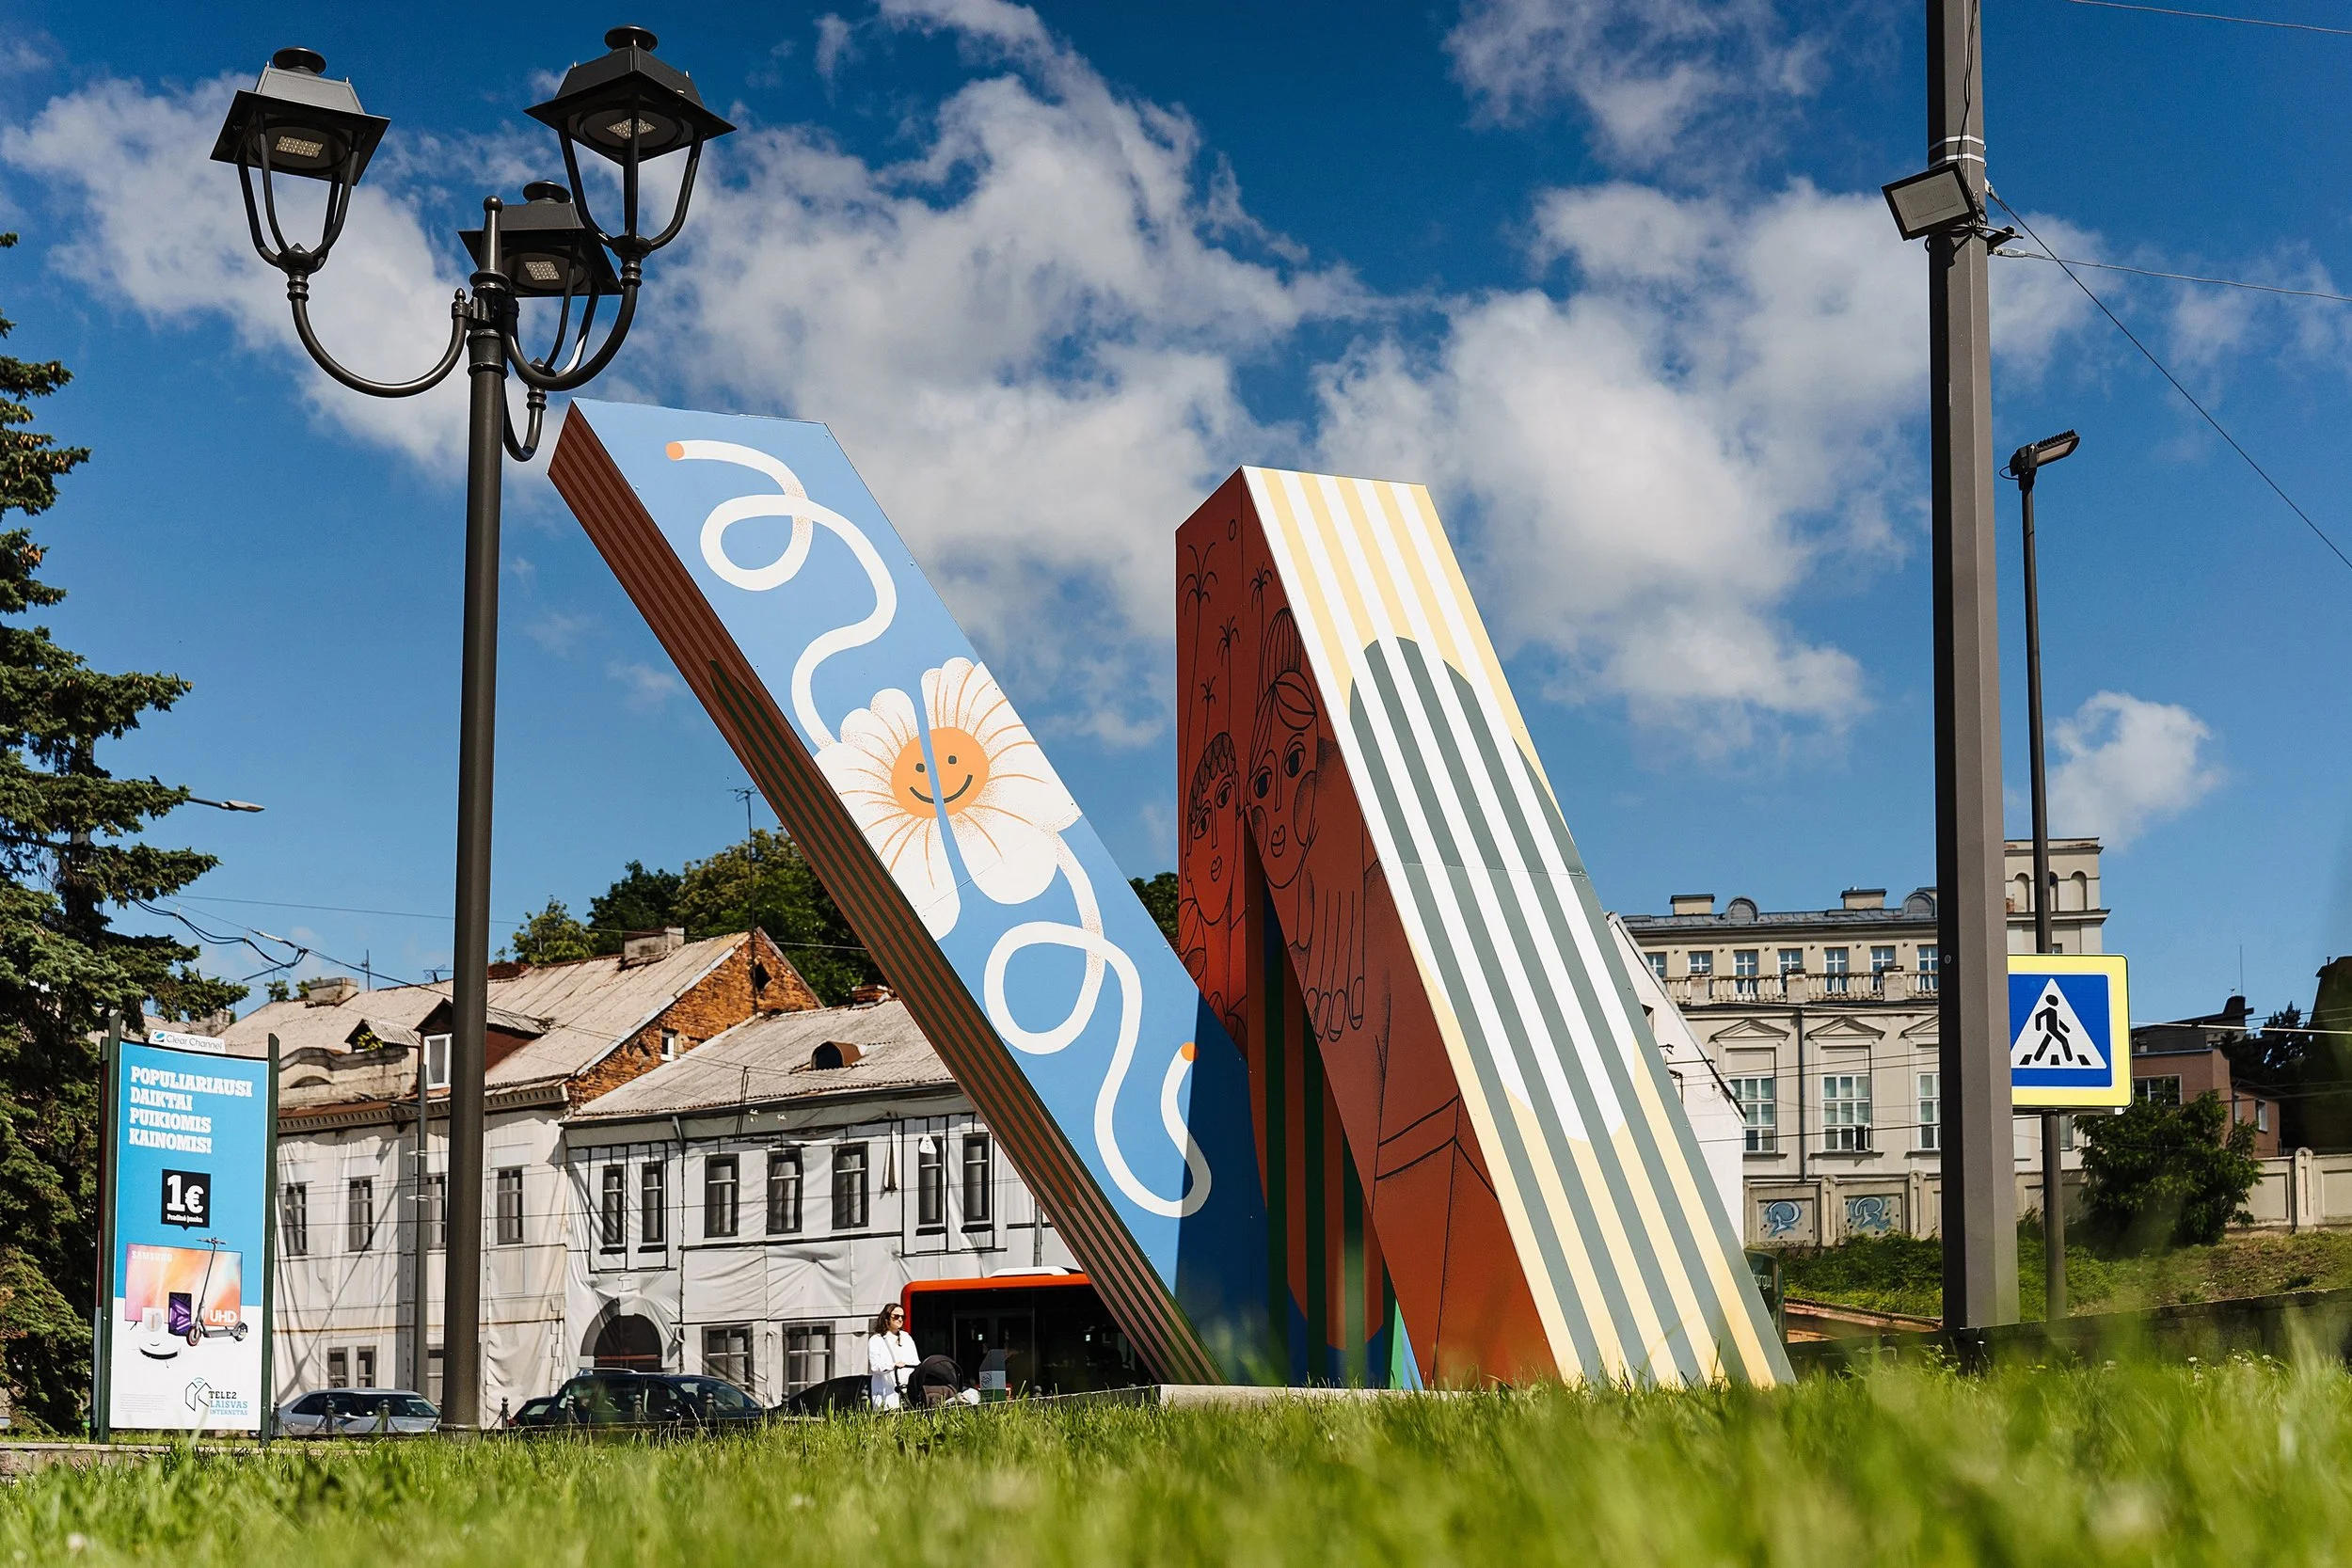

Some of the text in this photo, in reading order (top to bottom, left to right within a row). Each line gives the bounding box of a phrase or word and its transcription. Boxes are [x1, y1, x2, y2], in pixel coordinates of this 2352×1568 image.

[167, 1034, 223, 1050] Clear Channel
[131, 1066, 253, 1098] POPULIARIAUSI
[130, 1086, 193, 1112] DAIKTAI
[129, 1107, 212, 1133] PUIKIOMIS
[129, 1128, 212, 1154] KAINOMIS!
[167, 1174, 204, 1213] 1€
[209, 1309, 237, 1323] UHD
[208, 1390, 237, 1400] TELE2
[210, 1400, 248, 1409] LAISVAS
